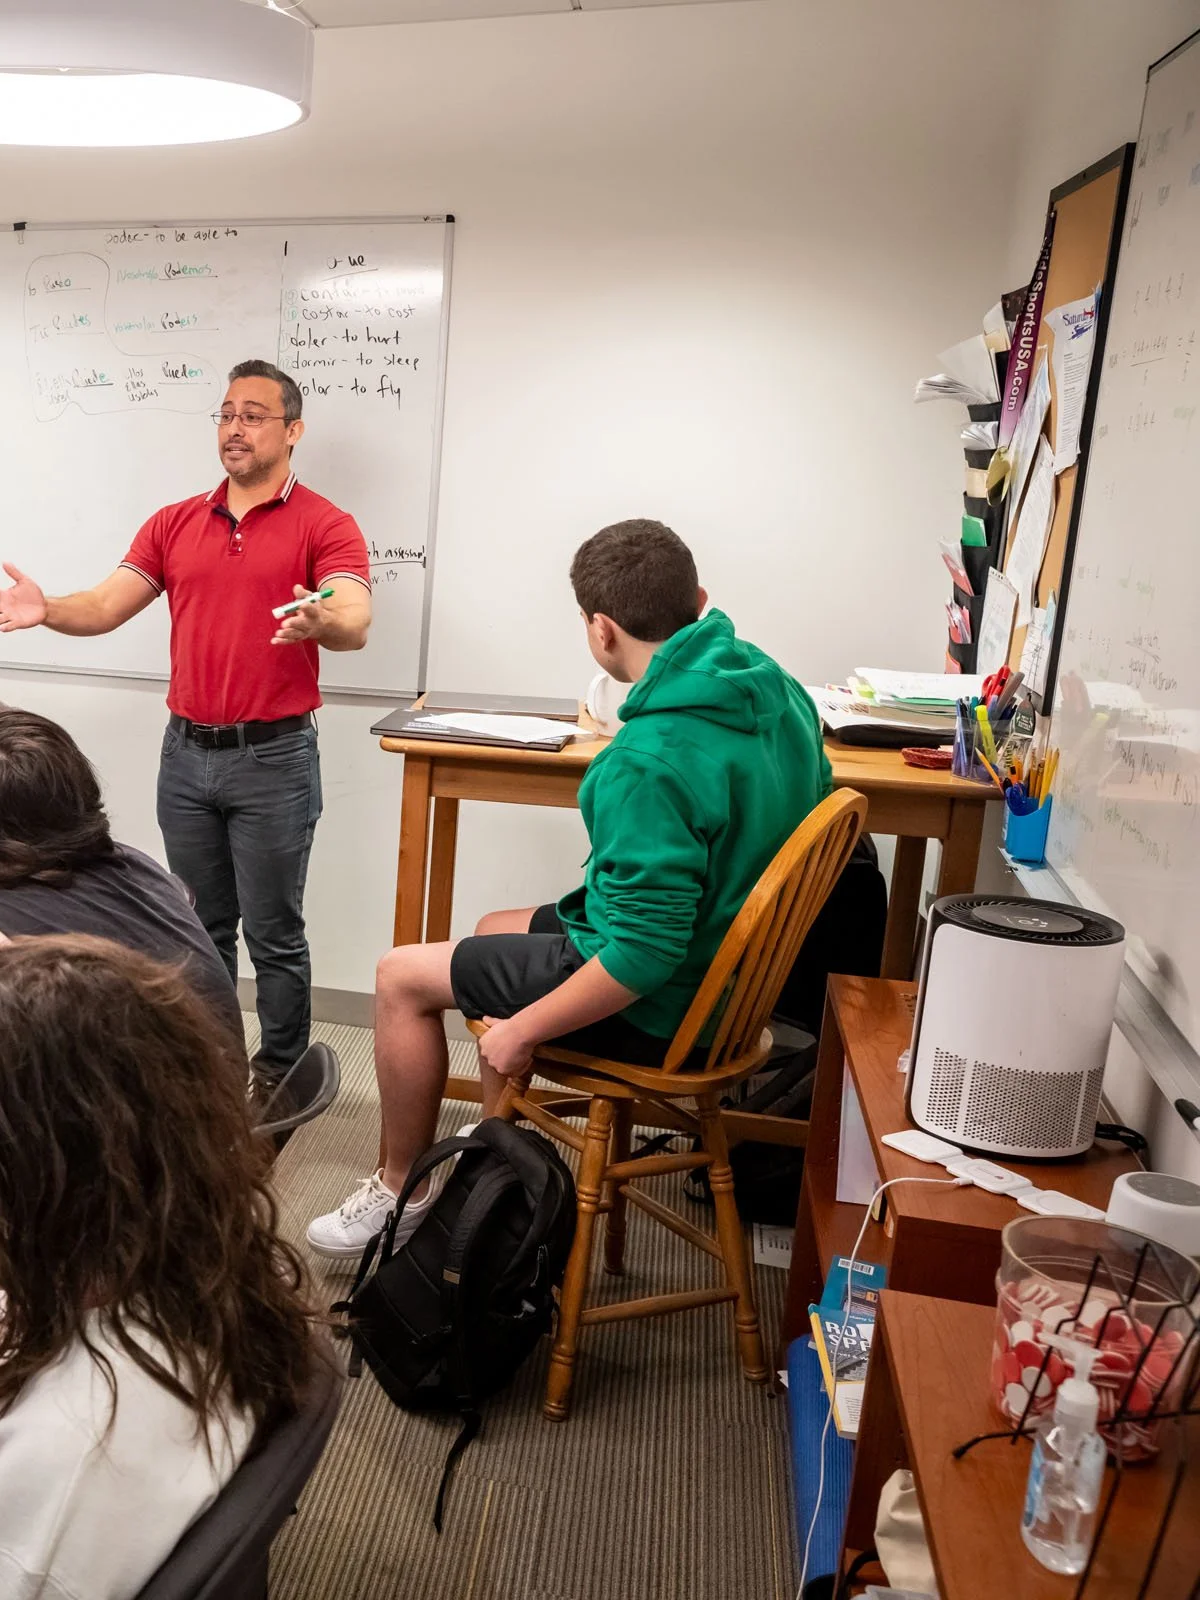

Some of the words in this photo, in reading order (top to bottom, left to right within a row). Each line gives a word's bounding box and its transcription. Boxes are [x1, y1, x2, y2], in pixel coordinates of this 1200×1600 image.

[174, 229, 189, 243] be
[224, 227, 238, 238] to
[163, 261, 213, 279] Podemos
[388, 304, 416, 319] cost
[290, 322, 328, 349] doler
[342, 328, 359, 343] to
[367, 326, 403, 345] hurt
[1007, 238, 1052, 412] rideSportsUSA.com
[291, 350, 337, 368] dormir
[356, 352, 373, 366] to
[384, 352, 420, 372] sleep
[350, 377, 368, 396] to
[376, 374, 402, 412] fly
